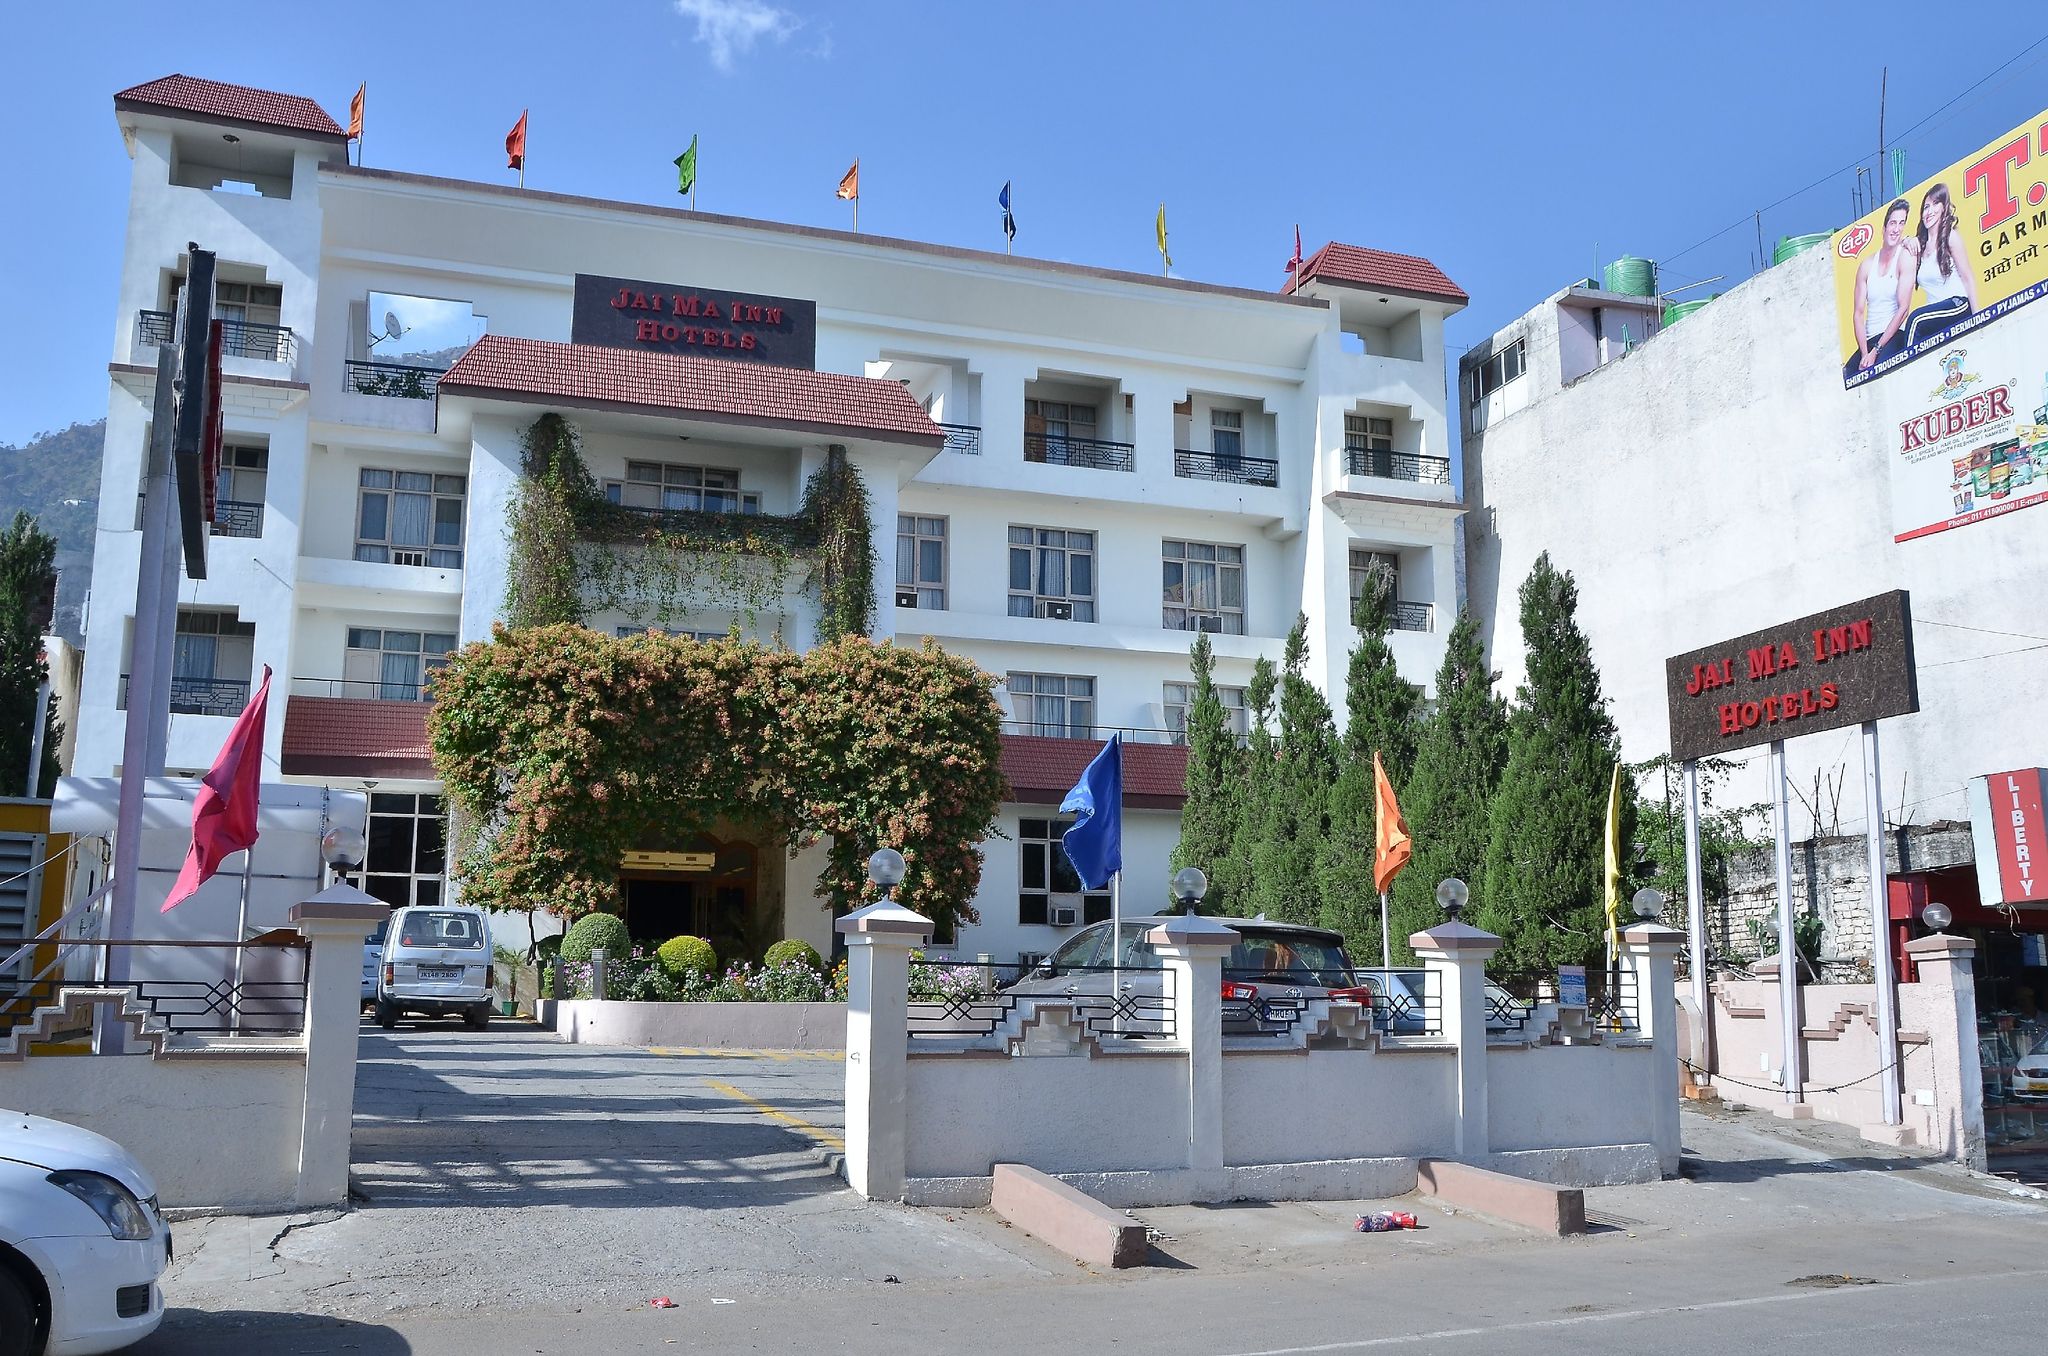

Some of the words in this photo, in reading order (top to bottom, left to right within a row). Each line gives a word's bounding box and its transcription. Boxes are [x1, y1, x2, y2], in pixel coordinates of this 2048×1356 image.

[1983, 257, 2012, 283] अच्छे
[2015, 244, 2039, 267] लगे
[611, 287, 662, 311] JAI
[672, 294, 720, 318] MA
[731, 301, 783, 325] INN
[636, 319, 757, 351] HOTELS
[1845, 370, 1869, 388] SHIRTS
[1873, 350, 1909, 375] TROUSERS
[1913, 332, 1945, 355] T-SHIRTS
[1949, 309, 1991, 337] BERMUDAS
[1996, 288, 2035, 315] PYJAMAS
[1900, 385, 2013, 453] KUBER
[1947, 517, 1970, 528] Phone:
[1971, 512, 1982, 521] 011
[1686, 658, 1735, 698] JAI
[1747, 641, 1799, 680] MA
[1811, 618, 1873, 663] INN
[1718, 681, 1839, 736] HOTELS
[2007, 775, 2034, 897] LIBERTY
